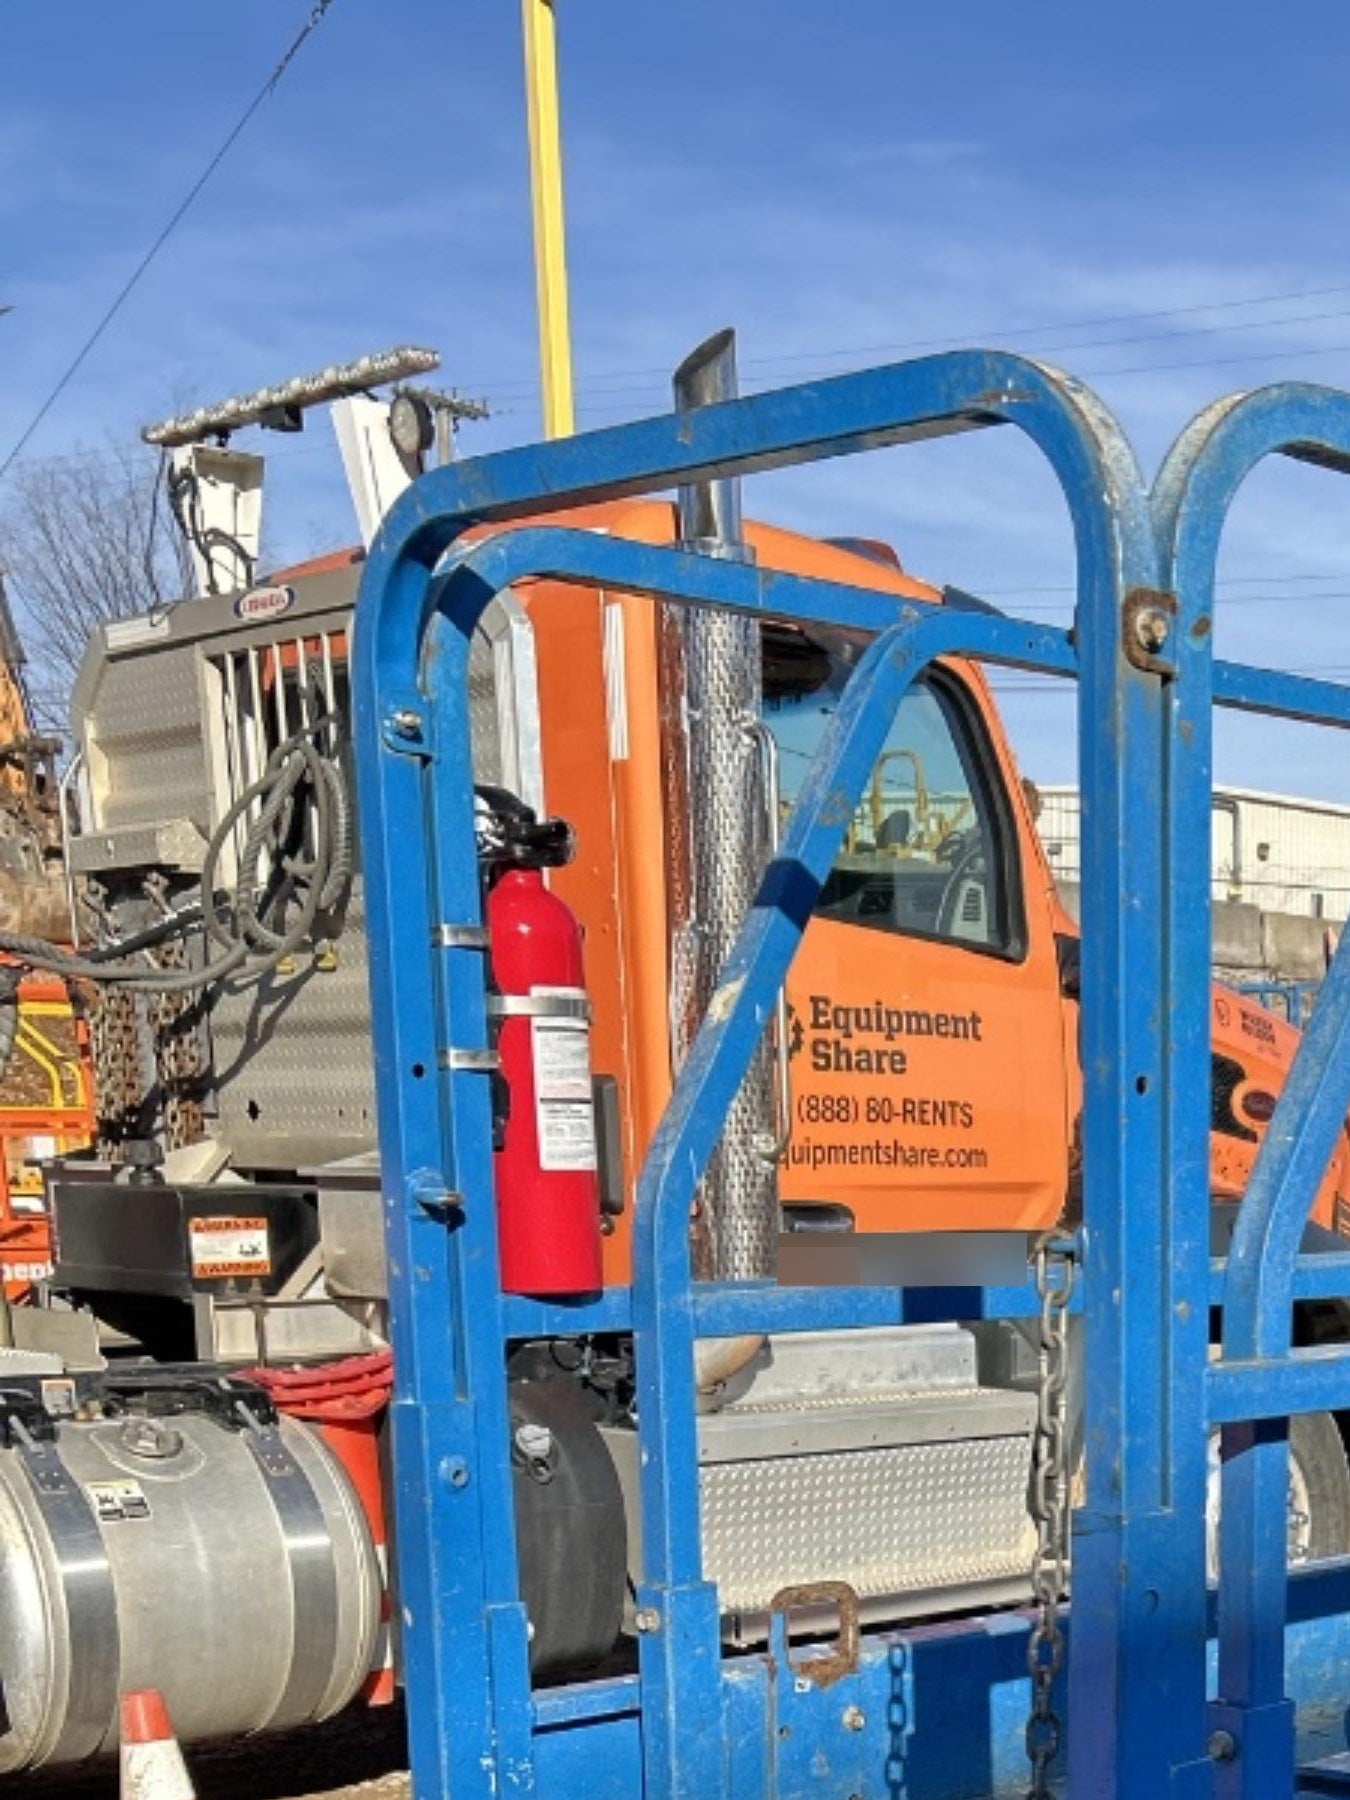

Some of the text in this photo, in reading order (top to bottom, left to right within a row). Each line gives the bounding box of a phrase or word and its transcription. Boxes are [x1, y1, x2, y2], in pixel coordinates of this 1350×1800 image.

[809, 995, 983, 1042] Equipment
[811, 1037, 908, 1075] Share
[797, 1094, 974, 1129] (888) 80-RENTS
[779, 1137, 988, 1171] quipmentshare.com
